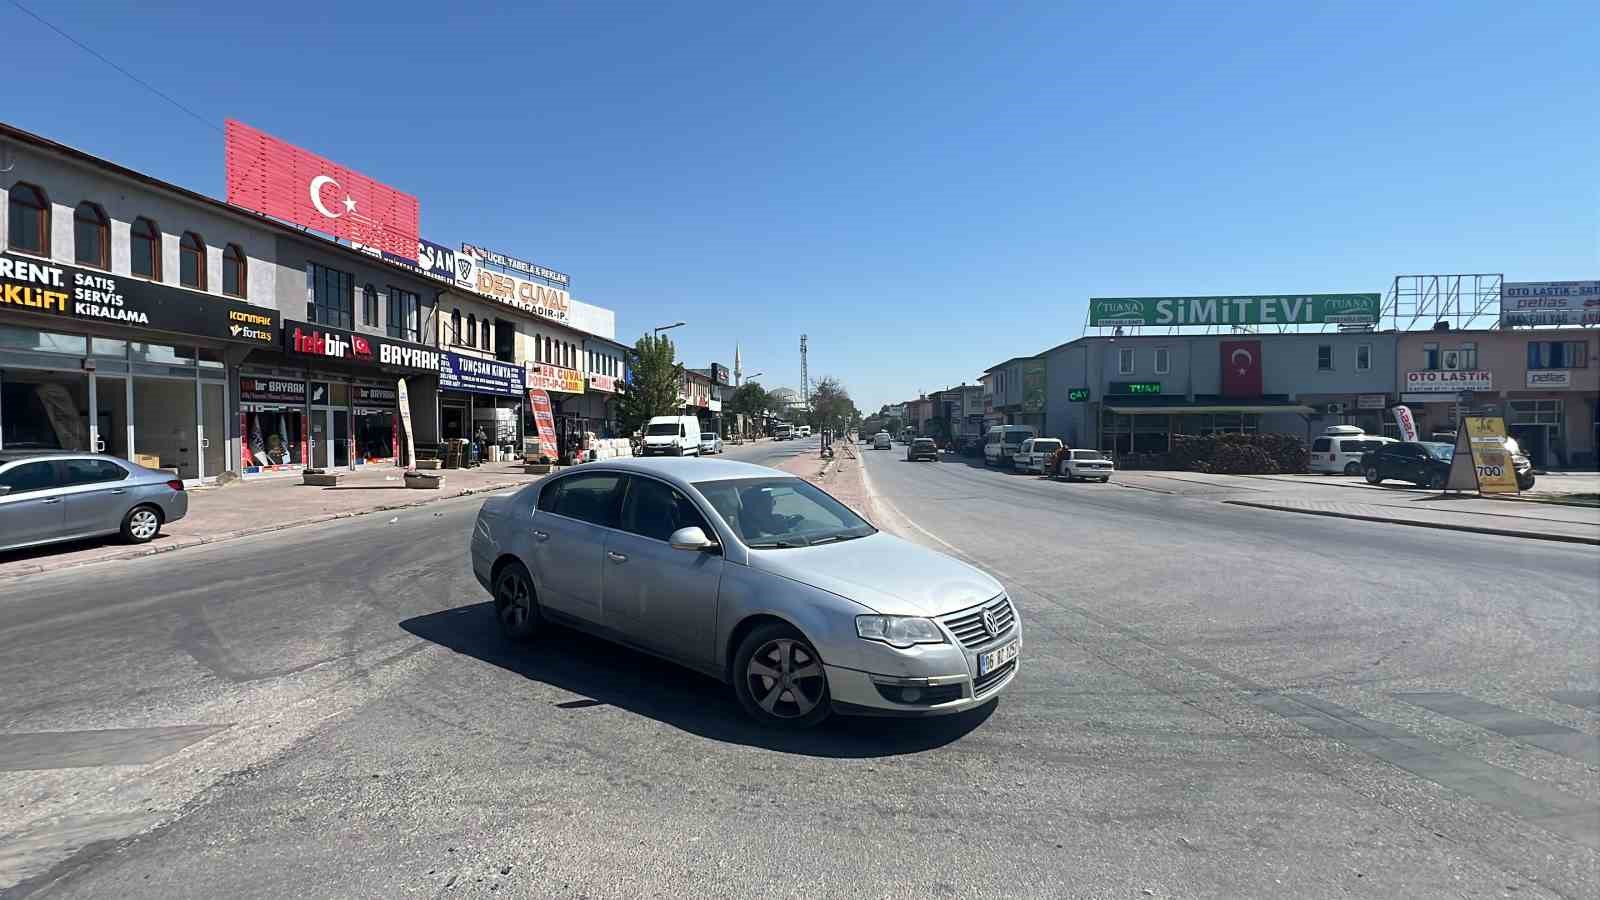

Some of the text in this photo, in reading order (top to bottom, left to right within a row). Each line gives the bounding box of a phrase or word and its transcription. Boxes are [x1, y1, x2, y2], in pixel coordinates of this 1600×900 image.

[74, 273, 115, 292] SATIŞ
[1508, 287, 1529, 296] OTO
[242, 327, 272, 342] fortaş
[379, 343, 439, 370] BAYRAK
[1408, 372, 1437, 382] OTO
[268, 381, 305, 394] BAYRAK
